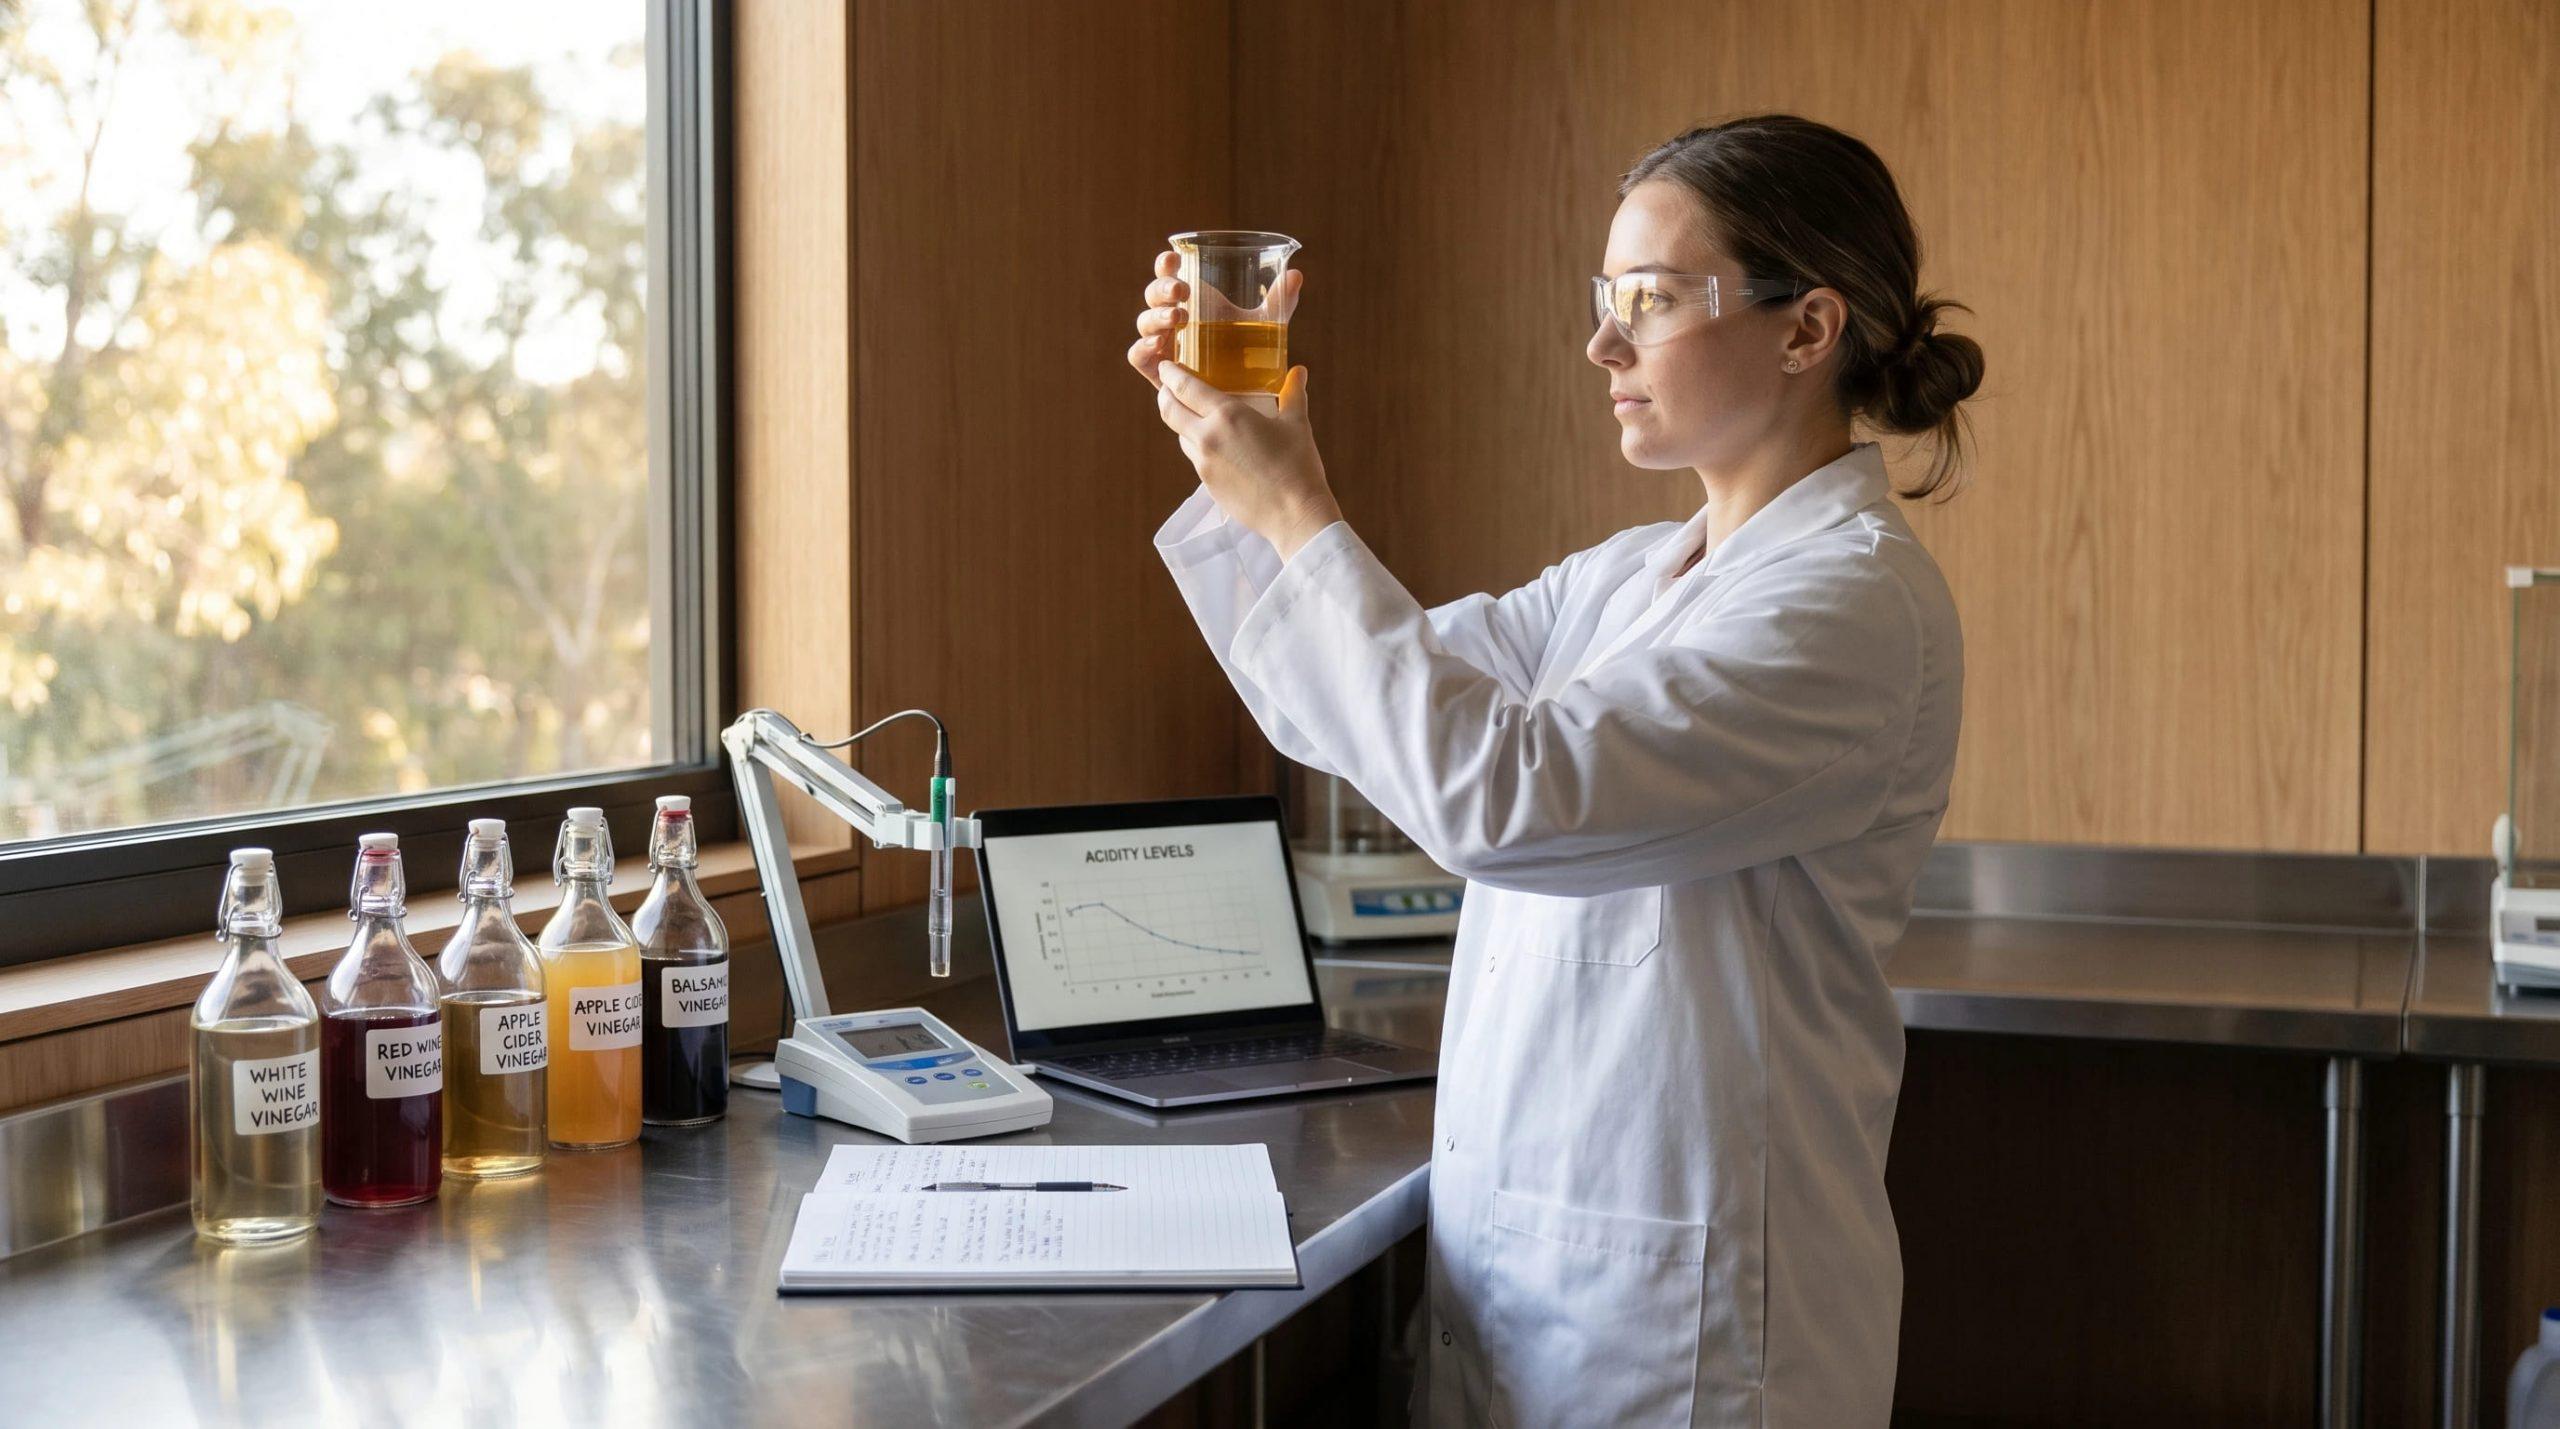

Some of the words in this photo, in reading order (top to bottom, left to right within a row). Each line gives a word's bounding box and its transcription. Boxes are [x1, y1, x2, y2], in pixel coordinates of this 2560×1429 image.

[1085, 847, 1139, 863] ACIDITY
[1142, 844, 1195, 860] LEVELS
[574, 998, 620, 1015] APPLE
[624, 993, 643, 1010] CIDE
[497, 1011, 541, 1032] APPLE
[586, 1016, 641, 1036] VINEGAR
[377, 1043, 413, 1060] RED
[416, 1034, 443, 1054] WINE
[503, 1030, 542, 1050] CIDER
[495, 1046, 547, 1069] VINEGAR
[249, 1061, 307, 1084] WHITE
[261, 1083, 306, 1103] WINE
[250, 1101, 318, 1128] VINEGAR
